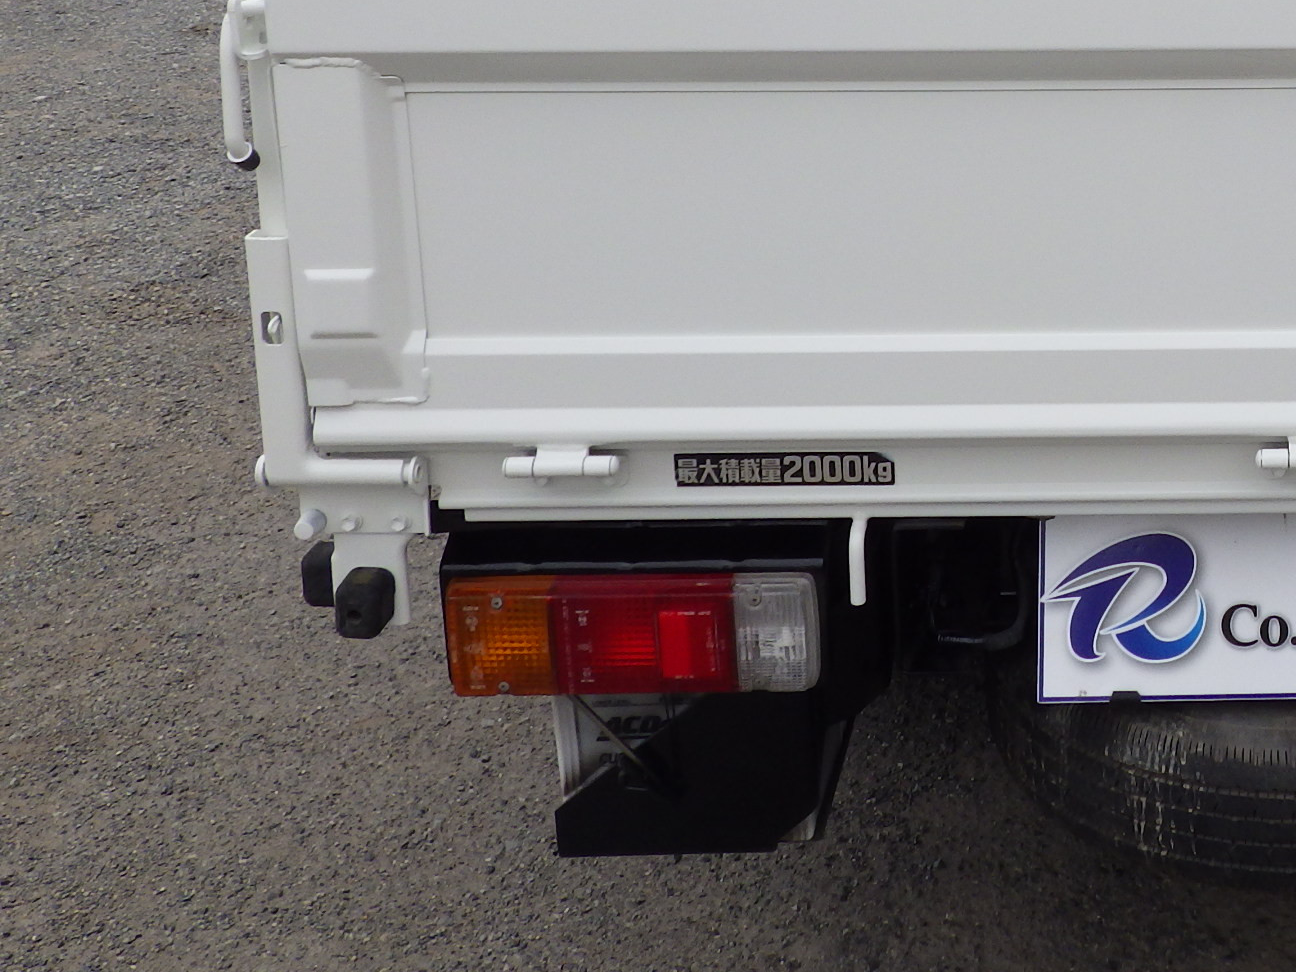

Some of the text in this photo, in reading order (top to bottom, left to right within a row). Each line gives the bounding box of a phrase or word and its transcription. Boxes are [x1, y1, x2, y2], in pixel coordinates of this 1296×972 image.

[677, 455, 892, 483] 最大積載量2000kg
